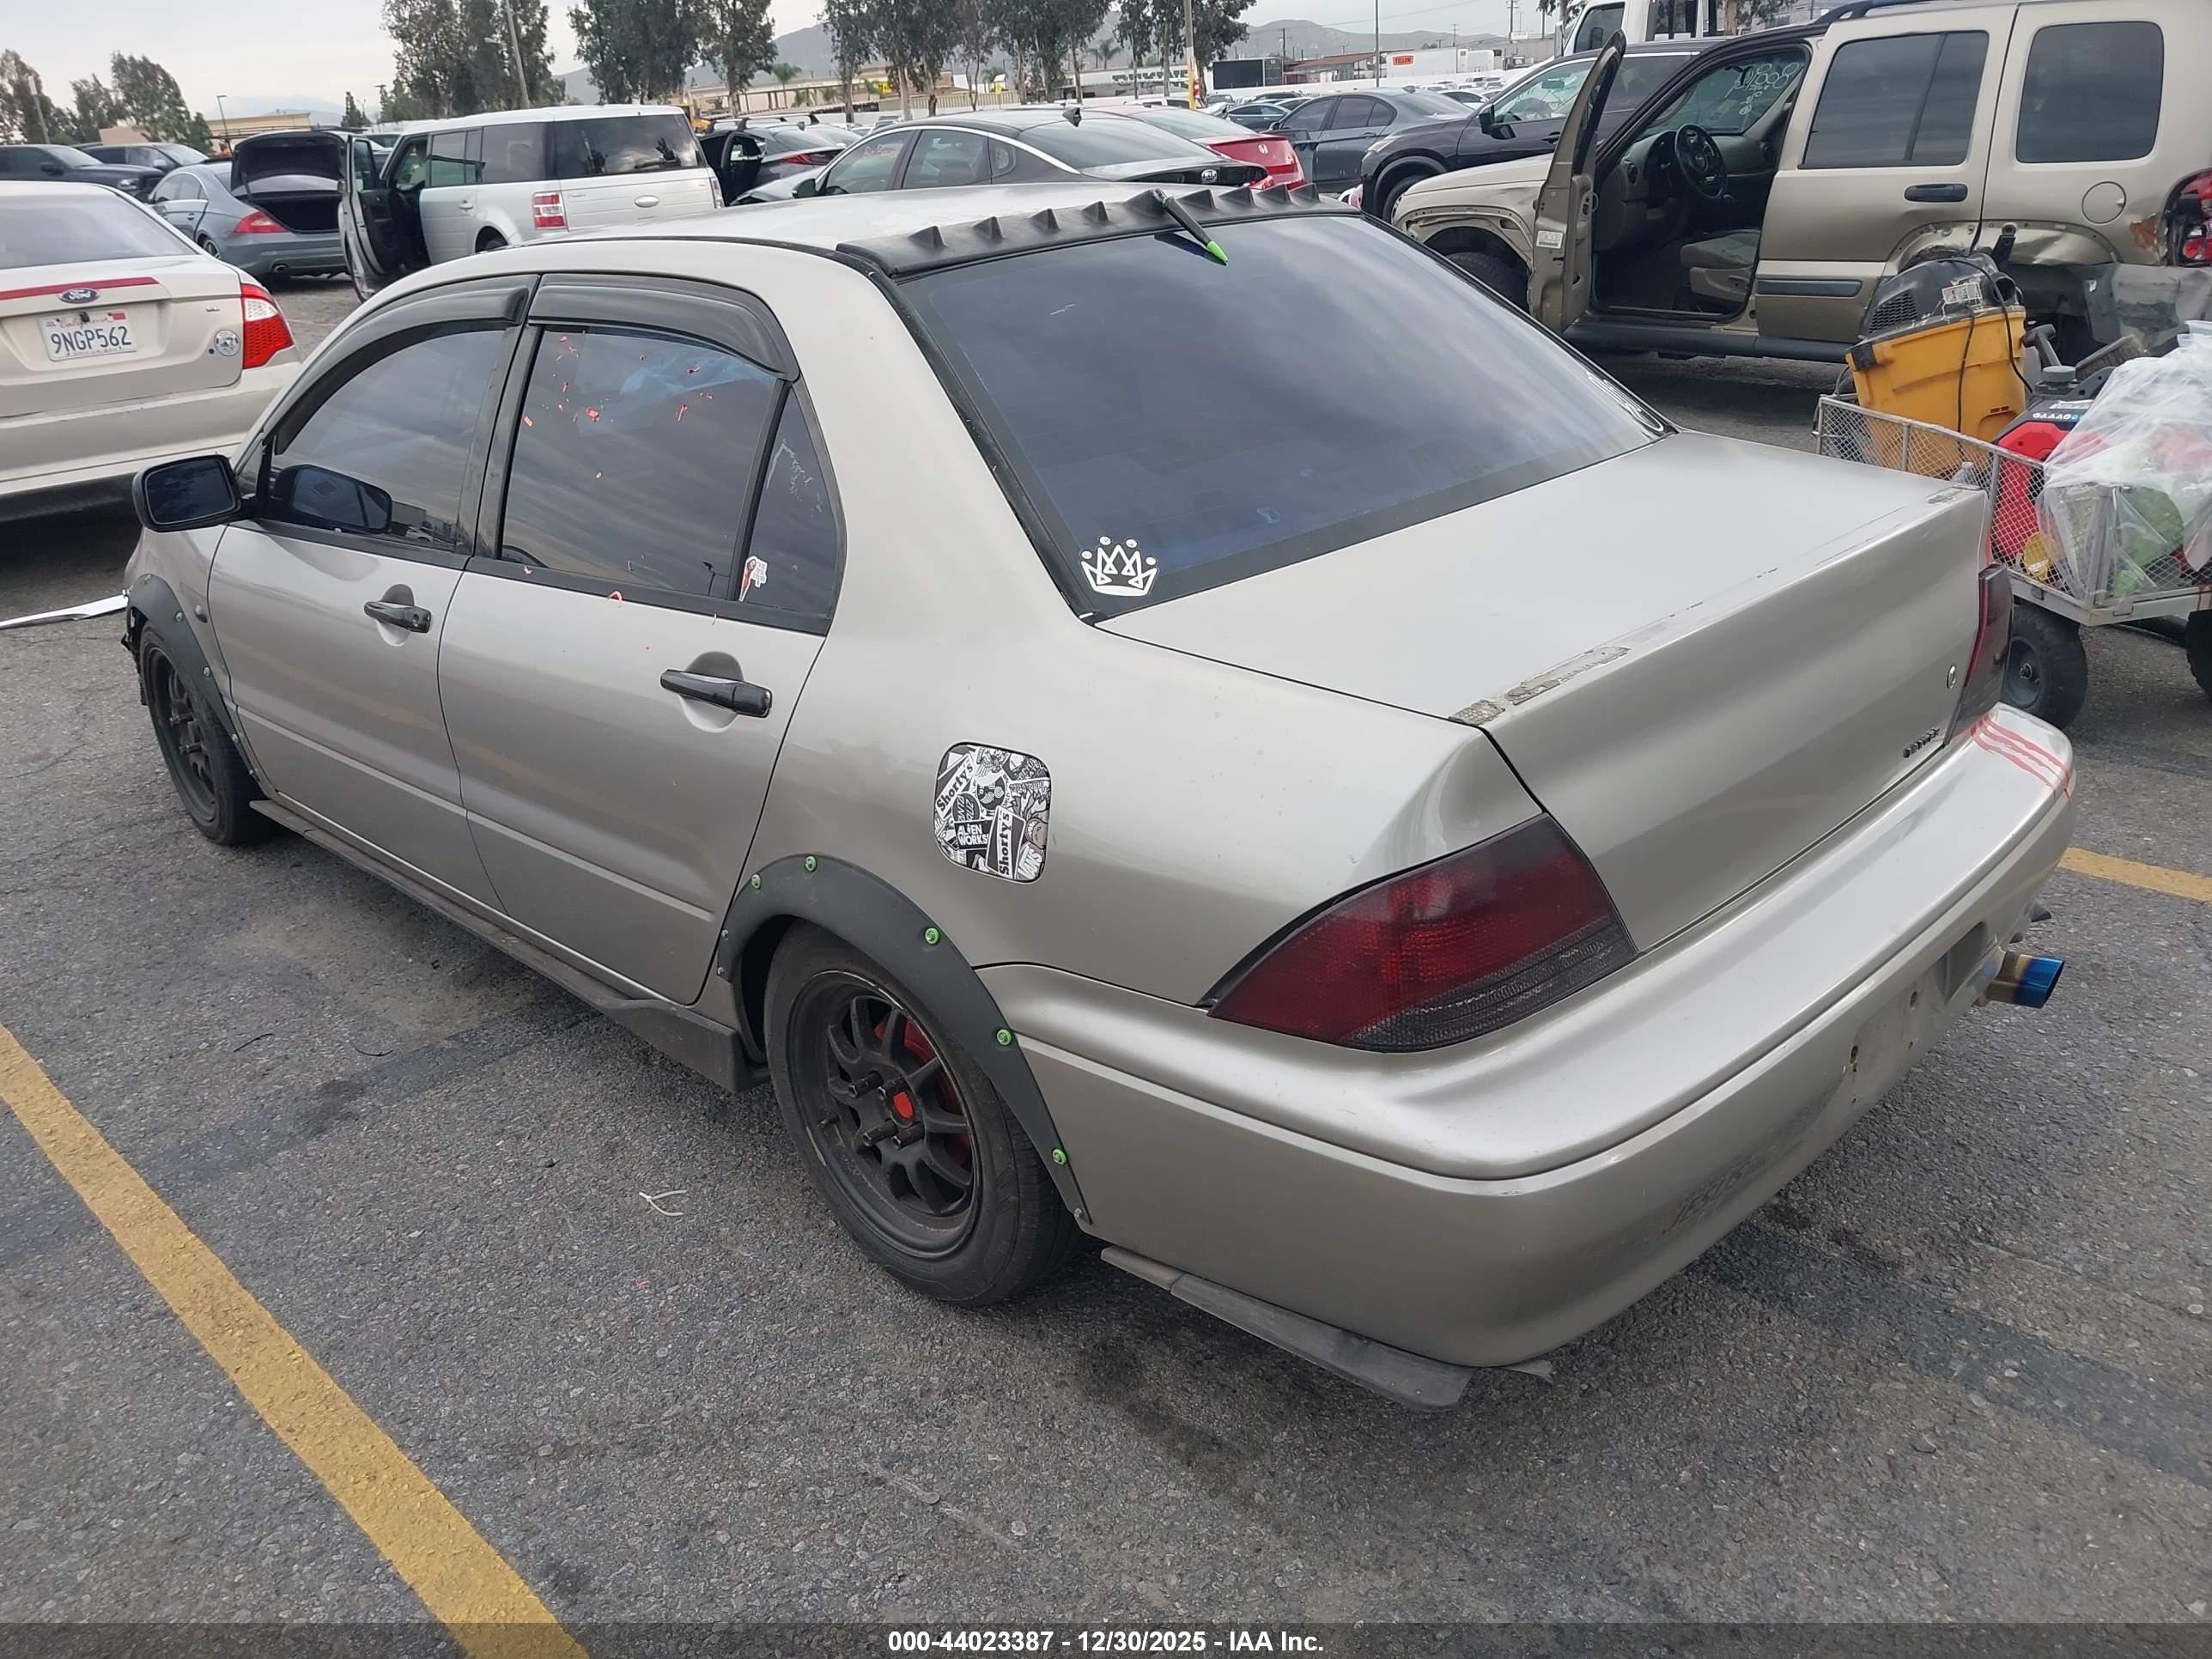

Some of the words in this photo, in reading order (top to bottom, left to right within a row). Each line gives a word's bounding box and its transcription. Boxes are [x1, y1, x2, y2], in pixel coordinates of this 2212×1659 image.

[51, 325, 132, 354] 9NGP562
[936, 761, 974, 812] Shorty's
[957, 834, 988, 847] WORKS
[999, 812, 1012, 876] Shorty's
[1017, 847, 1043, 880] VANS
